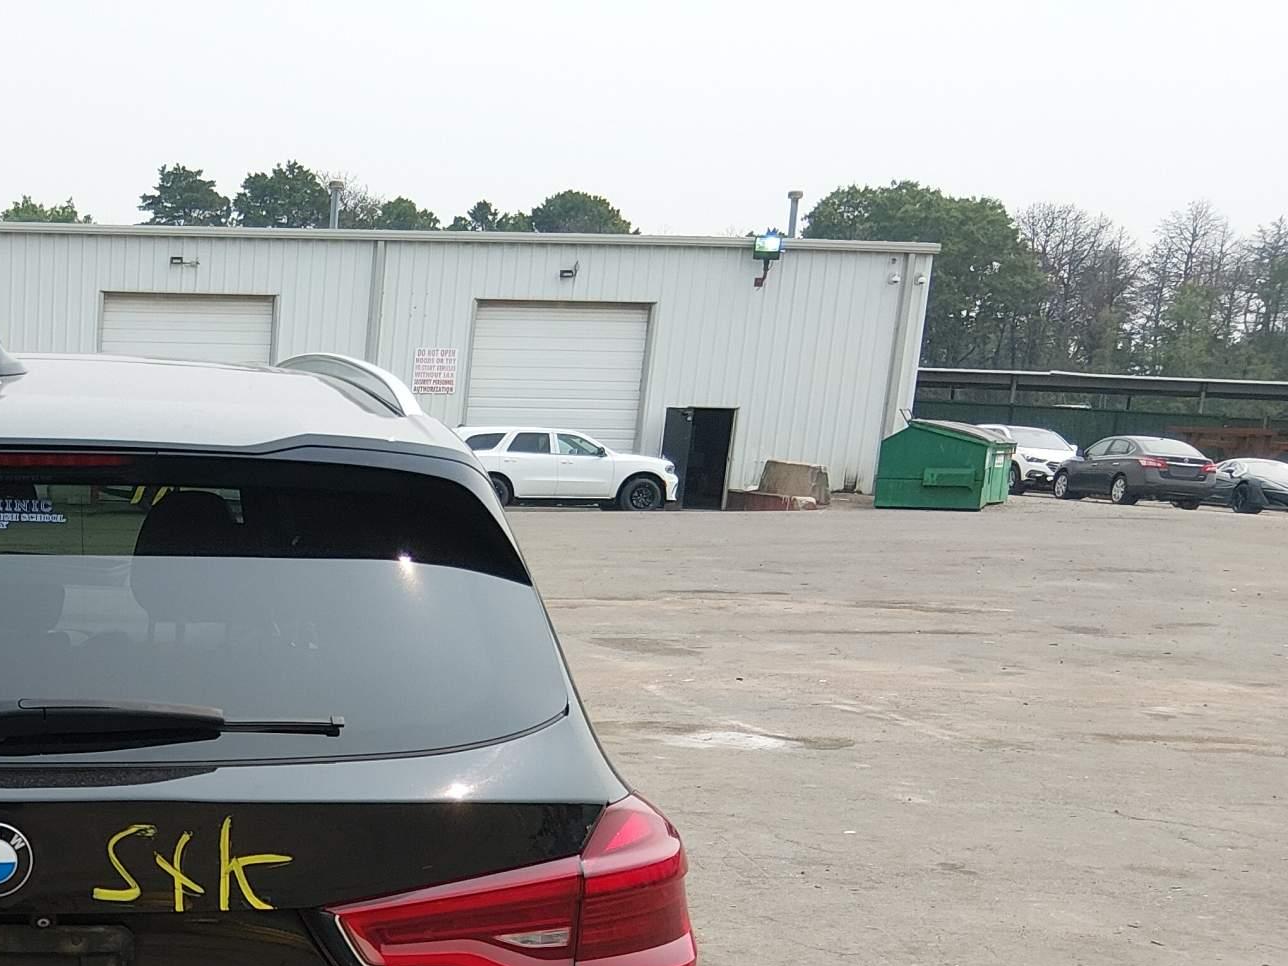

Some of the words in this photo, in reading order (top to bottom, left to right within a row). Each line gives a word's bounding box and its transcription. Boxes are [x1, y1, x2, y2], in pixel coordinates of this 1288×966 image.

[417, 349, 425, 357] DO
[428, 349, 439, 357] NOT
[440, 349, 456, 357] OPEN
[20, 513, 66, 522] SCHOOL
